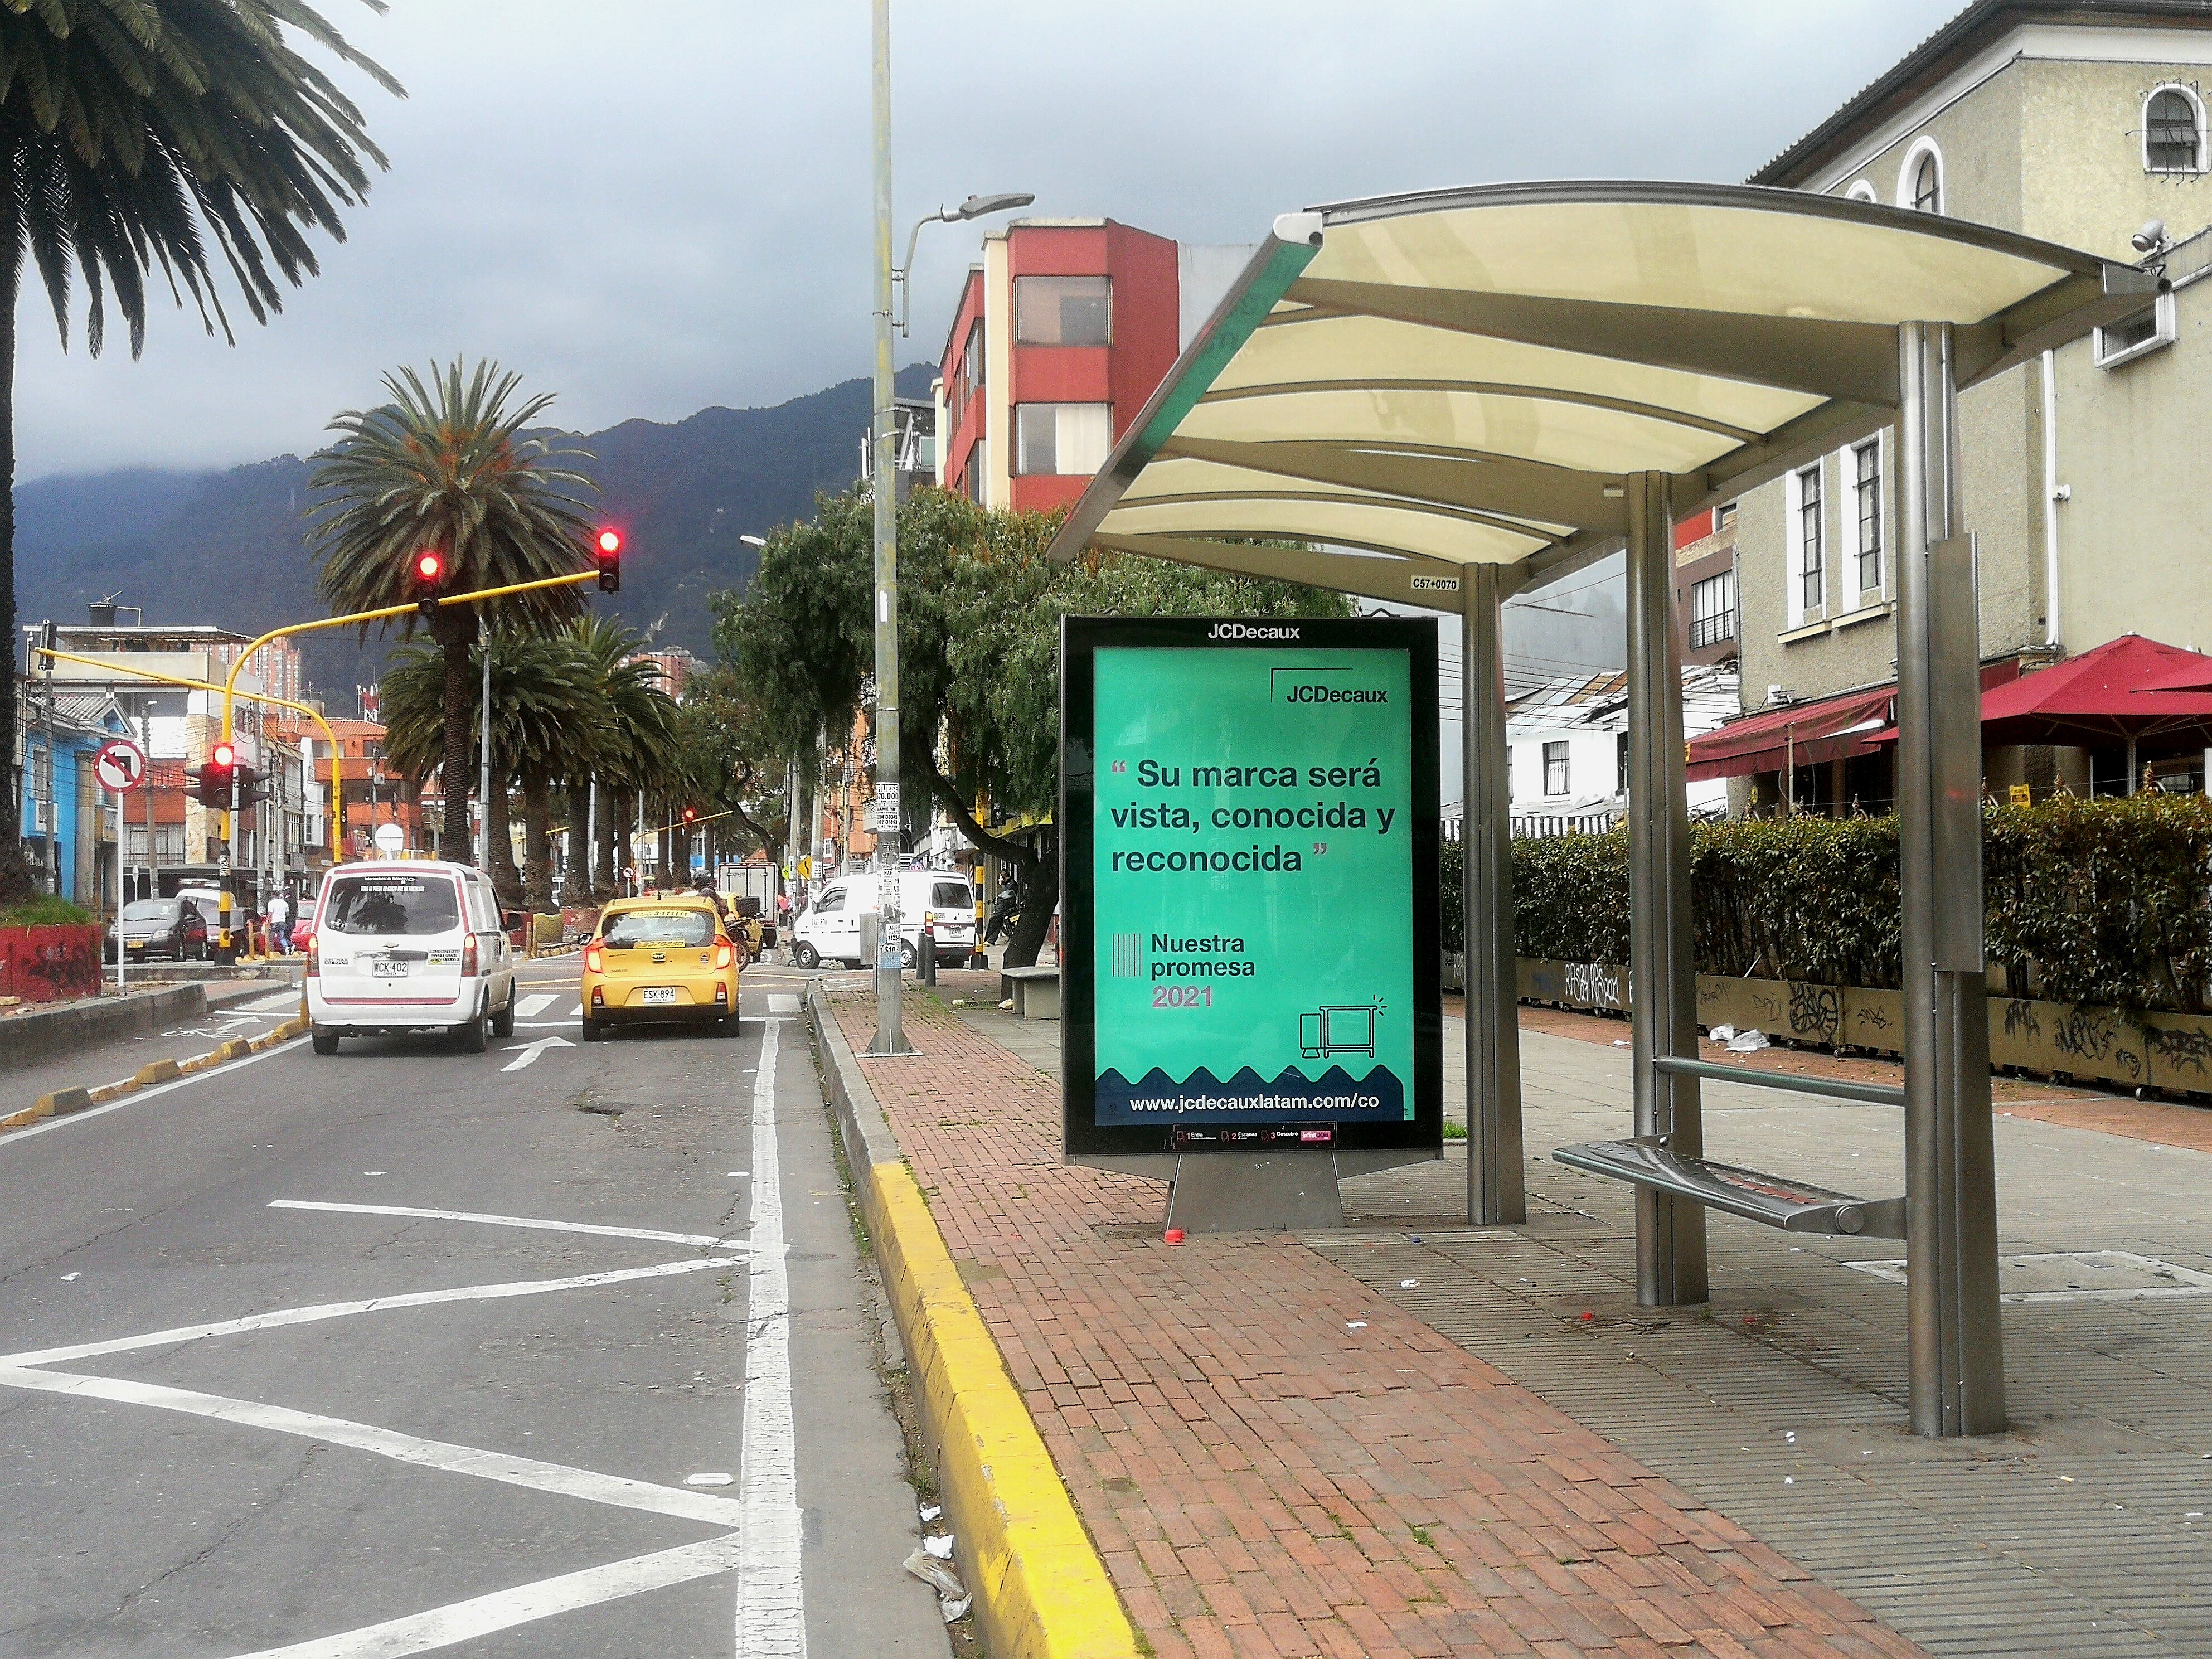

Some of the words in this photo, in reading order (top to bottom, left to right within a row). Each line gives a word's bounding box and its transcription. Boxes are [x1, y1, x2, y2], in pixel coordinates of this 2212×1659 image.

[1413, 578, 1457, 590] C57+0070
[1207, 623, 1300, 640] JCDecaux
[1286, 686, 1388, 704] JCDecaux
[1137, 759, 1181, 787] Su
[1192, 766, 1297, 787] marca
[1308, 758, 1381, 787] será
[1110, 802, 1199, 834] vista,
[1211, 802, 1366, 829] conocida
[1377, 808, 1395, 835] y
[1112, 845, 1302, 872] reconocida
[1151, 933, 1244, 953] Nuestra
[1151, 958, 1255, 981] promesa
[1152, 986, 1212, 1008] 2021
[1129, 1092, 1380, 1114] www.jcdecauxlatam.com/co
[1186, 1132, 1191, 1141] 1
